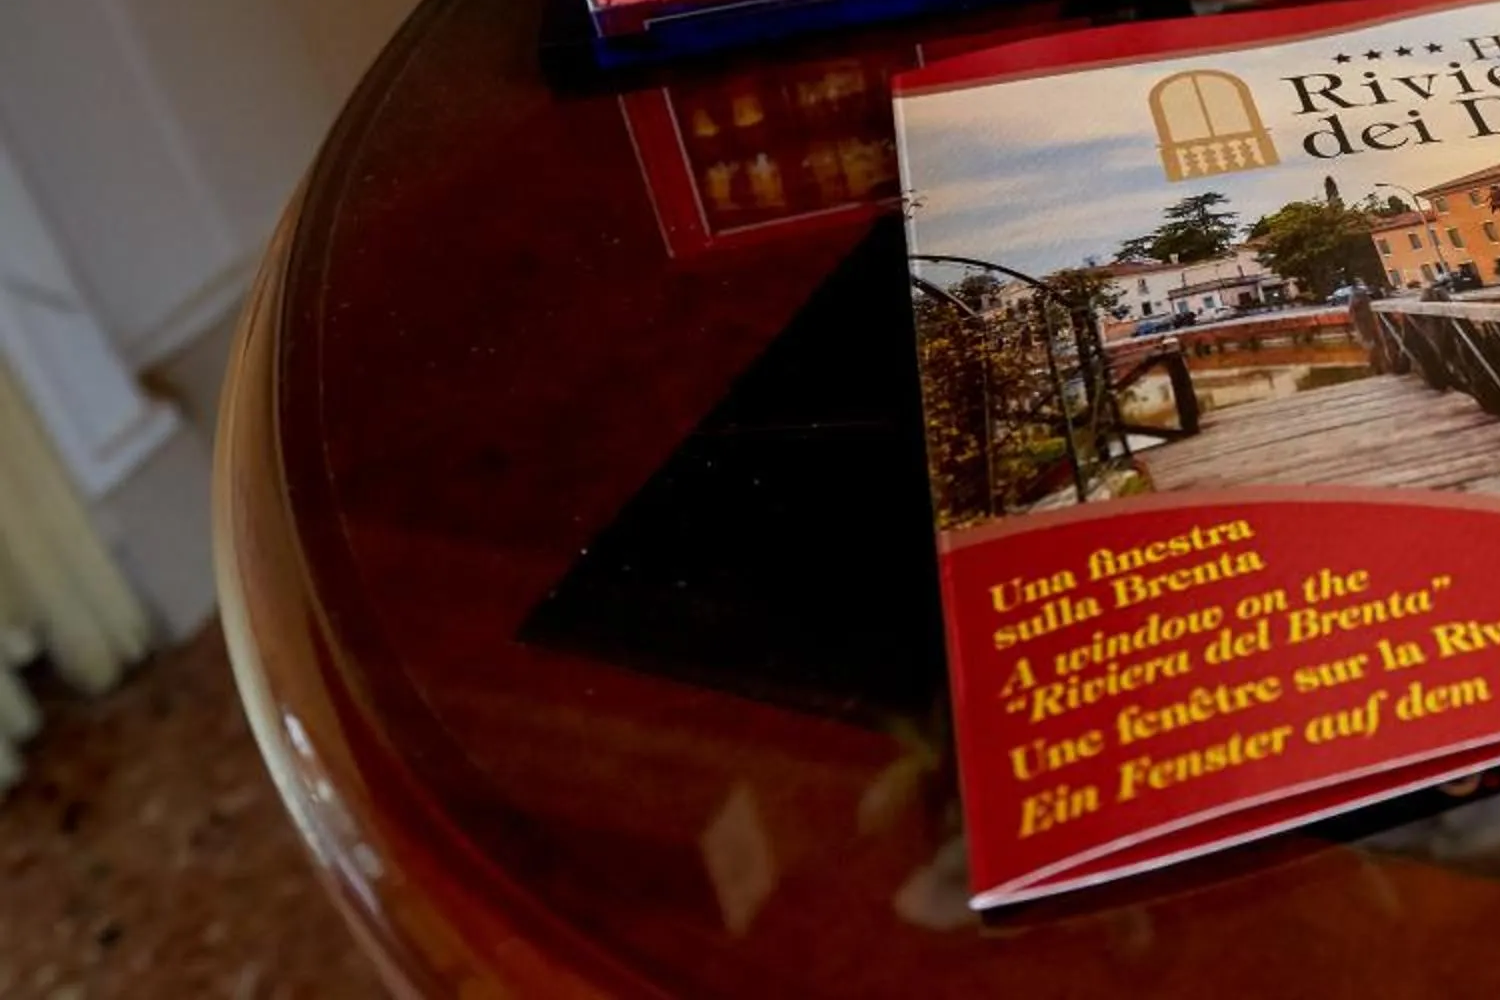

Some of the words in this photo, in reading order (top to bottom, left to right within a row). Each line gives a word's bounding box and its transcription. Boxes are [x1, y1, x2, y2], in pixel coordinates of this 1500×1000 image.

[1301, 107, 1441, 160] dei
[990, 569, 1077, 613] Una
[1088, 519, 1254, 581] finestra
[994, 597, 1102, 650] sulla
[1111, 548, 1266, 609] Brenta
[1001, 658, 1036, 697] A
[1055, 606, 1223, 675] window
[1236, 587, 1287, 620] on
[1303, 568, 1370, 603] the
[1006, 650, 1190, 723] “Riviera
[1205, 621, 1271, 665] del
[1288, 576, 1451, 644] Brenta”
[1010, 730, 1104, 782] Une
[1116, 675, 1282, 744] fenêtre
[1294, 652, 1368, 693] sur
[1379, 638, 1427, 671] la
[1018, 783, 1100, 839] Ein
[1118, 724, 1293, 802] Fenster
[1305, 689, 1388, 744] auf
[1395, 675, 1491, 723] dem
